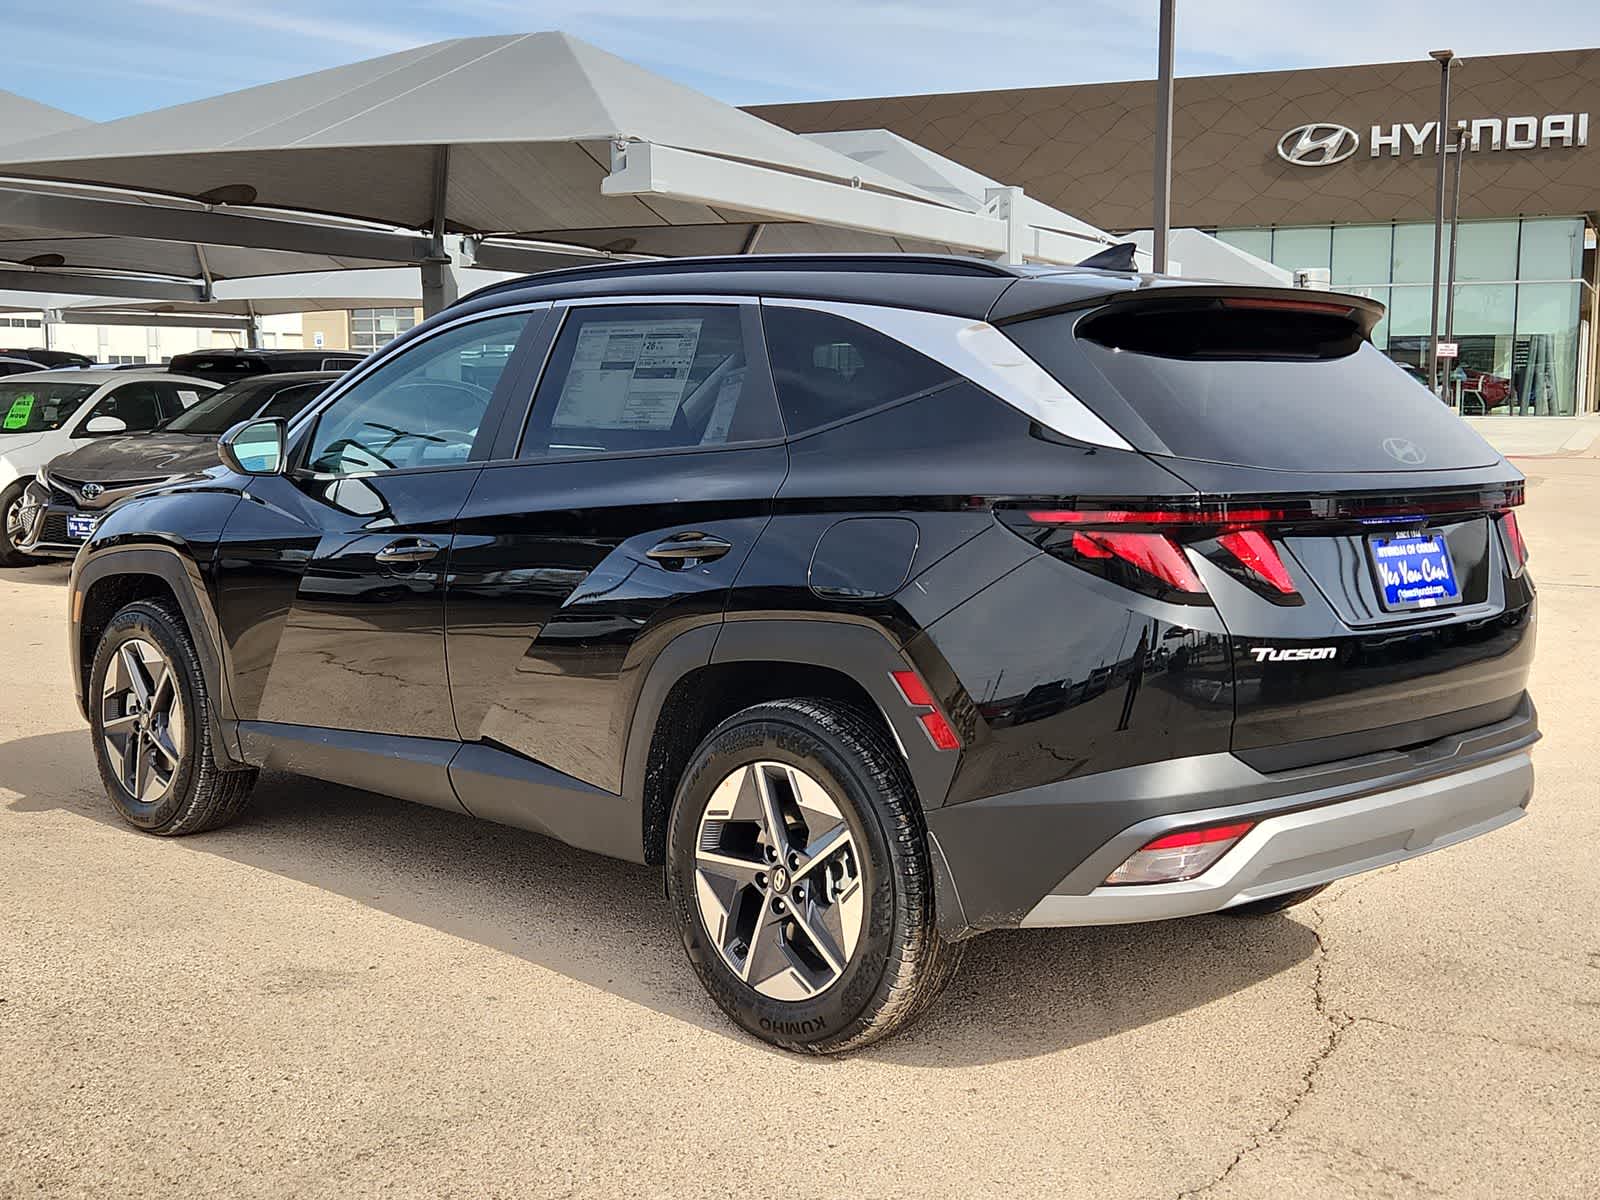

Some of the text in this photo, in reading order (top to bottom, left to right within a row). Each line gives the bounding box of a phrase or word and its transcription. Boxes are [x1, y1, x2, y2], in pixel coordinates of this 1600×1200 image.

[1378, 554, 1450, 587] Yes You Can!
[759, 1015, 826, 1035] KUMHO
